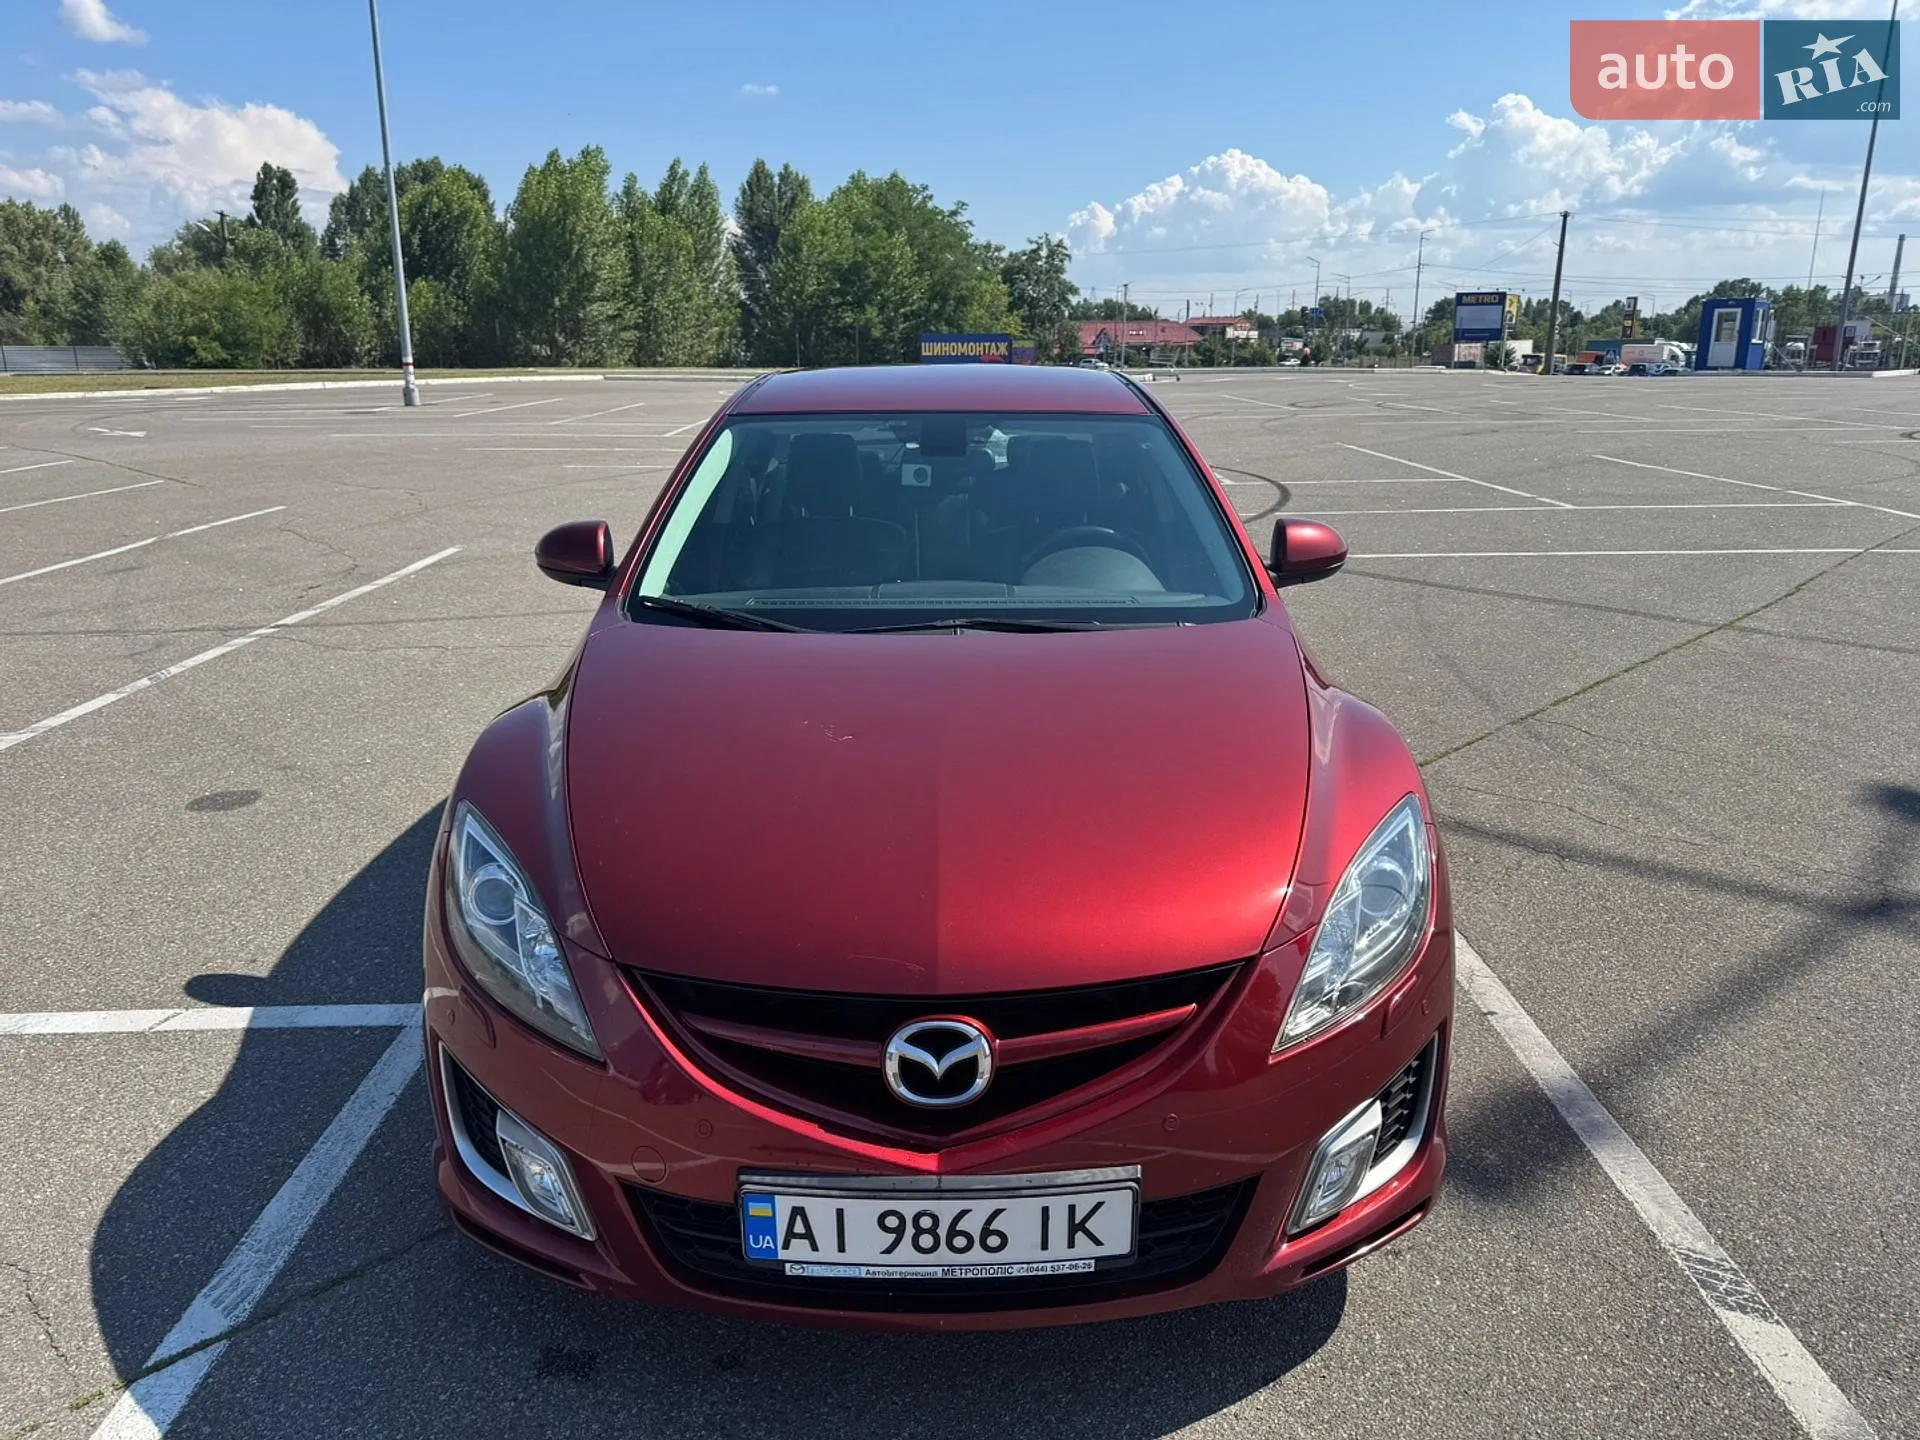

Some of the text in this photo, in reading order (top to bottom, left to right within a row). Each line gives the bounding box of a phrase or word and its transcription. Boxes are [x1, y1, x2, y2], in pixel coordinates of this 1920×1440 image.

[1462, 294, 1498, 304] METRO
[921, 342, 1008, 356] ШИНОМОНТАЖ
[781, 1200, 1105, 1255] AI 9866 IK
[749, 1234, 775, 1250] UA
